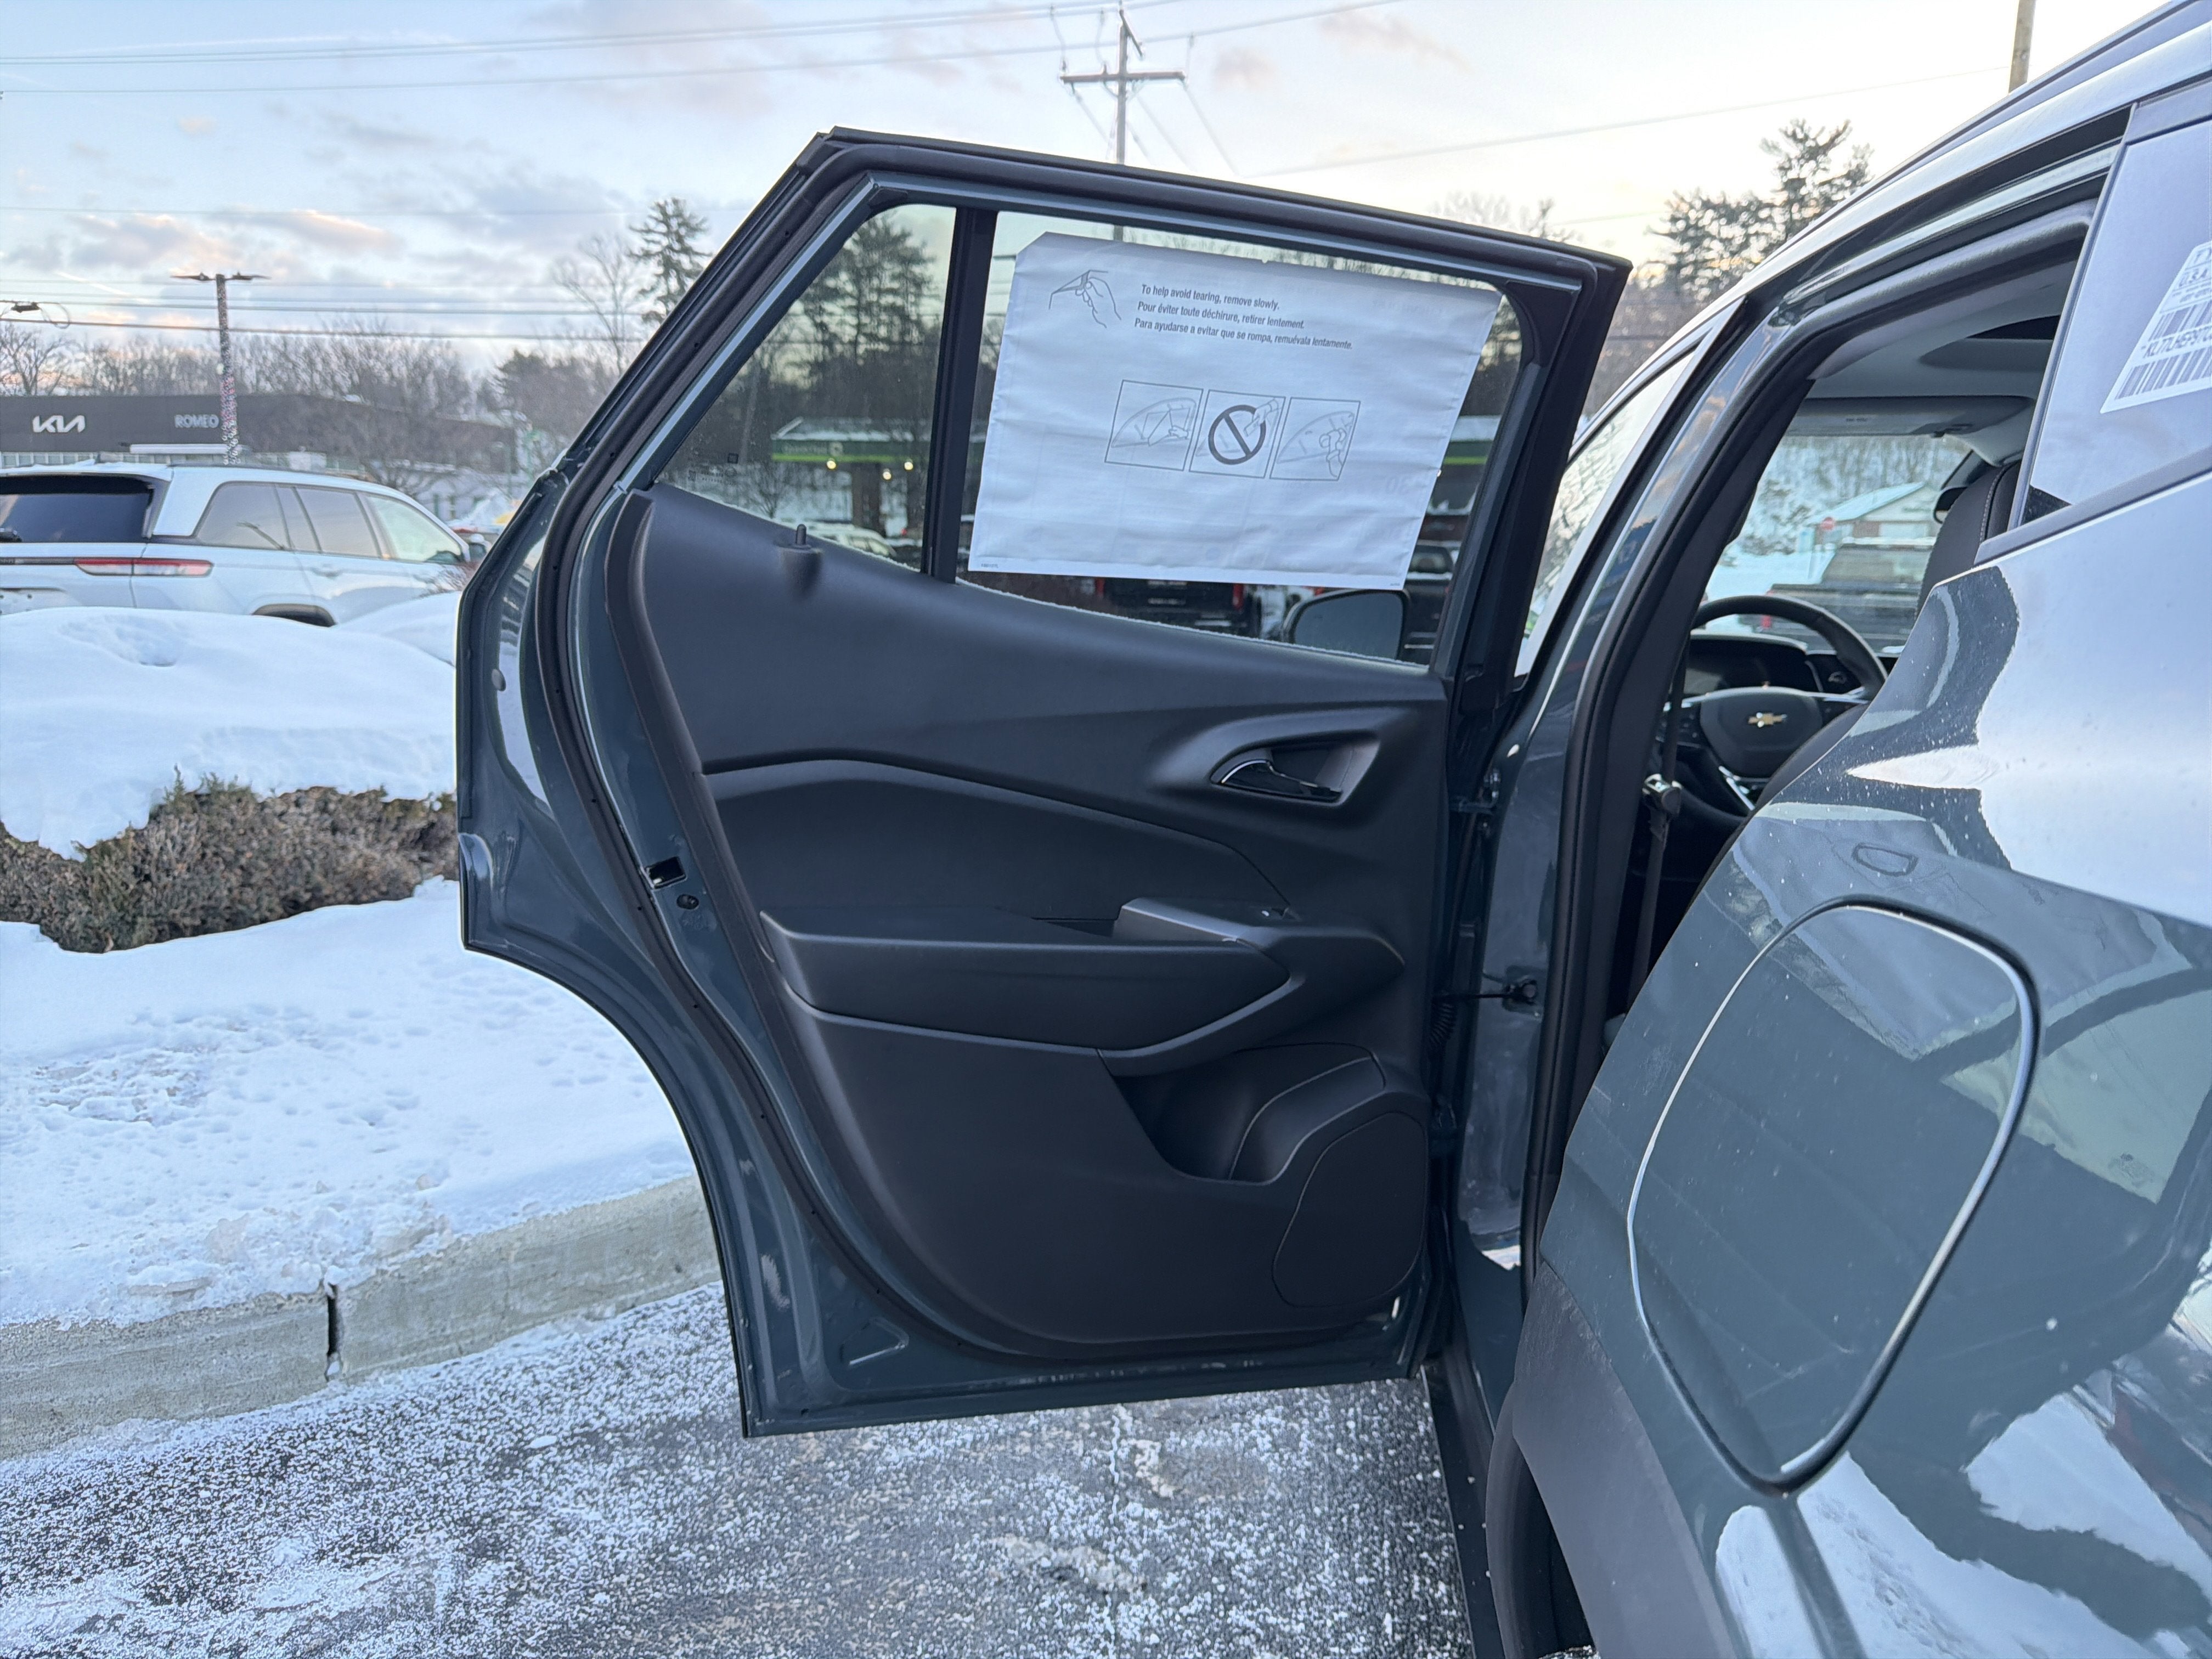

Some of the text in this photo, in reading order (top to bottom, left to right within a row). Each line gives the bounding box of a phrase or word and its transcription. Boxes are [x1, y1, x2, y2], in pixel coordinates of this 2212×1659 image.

[1142, 284, 1280, 312] To help avoid tearing, remove slowly.
[1137, 301, 1305, 329] Pour éviter toute déchirure, retirer lentement.
[1135, 318, 1153, 330] Para
[1154, 321, 1188, 333] ayudarse
[1197, 326, 1220, 336] evitar
[1221, 329, 1235, 340] que
[1236, 331, 1246, 340] se
[1247, 332, 1273, 345] rompa,
[1274, 334, 1312, 346] remuévala
[1312, 337, 1353, 349] lentamente.
[32, 415, 86, 433] KIA
[174, 414, 219, 428] ROMEO
